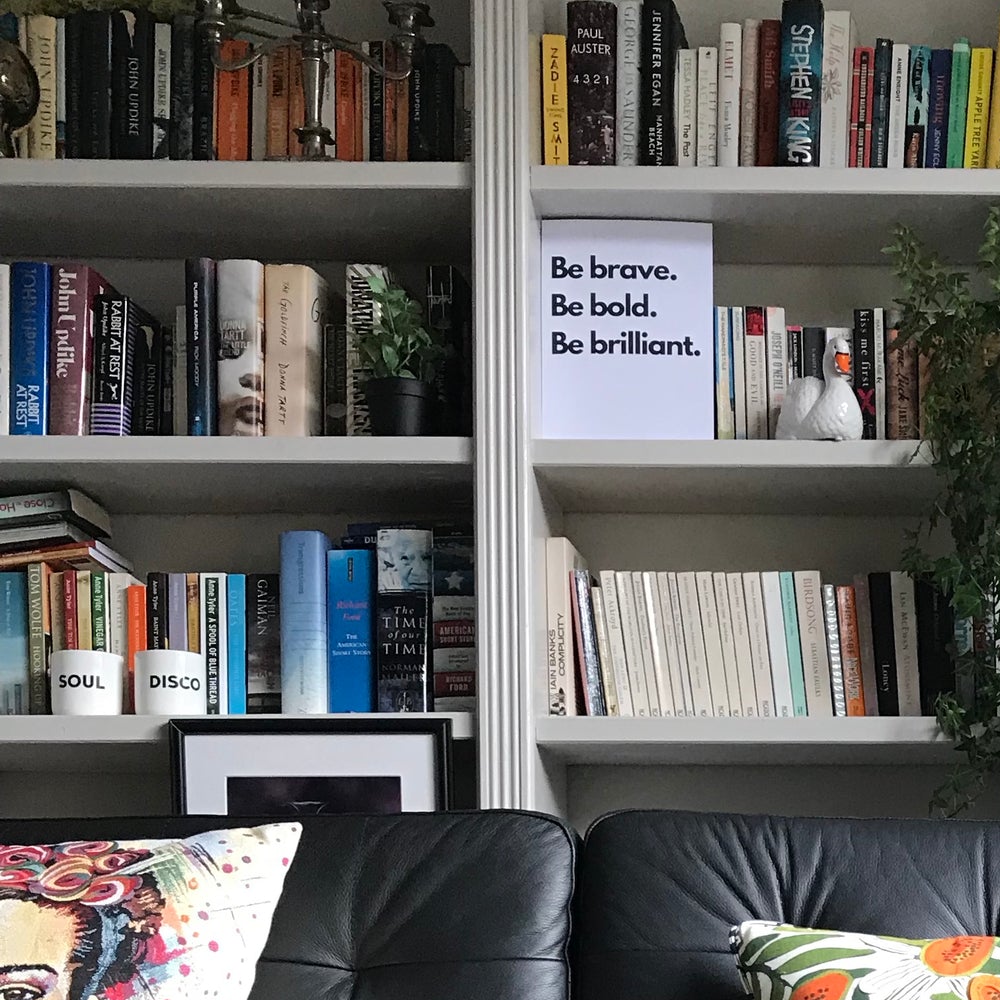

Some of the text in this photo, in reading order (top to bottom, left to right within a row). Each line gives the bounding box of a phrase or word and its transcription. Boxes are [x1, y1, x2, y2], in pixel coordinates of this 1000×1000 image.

[570, 43, 611, 56] AUSTER
[577, 27, 604, 39] PAUL
[624, 6, 637, 69] GEORGE
[651, 9, 662, 107] JENNIFER EGAN
[764, 48, 777, 89] Smith
[788, 23, 817, 101] STEPHEN
[549, 47, 560, 106] ZADIE
[40, 37, 52, 152] JOHN UPDIKE
[128, 57, 140, 137] JOHN UPDIKE
[682, 57, 692, 158] TESSA HADLEY The Past
[971, 96, 984, 148] APPLE TREE
[548, 121, 559, 165] SMIT
[648, 126, 656, 157] BEACH
[786, 116, 814, 164] KING
[551, 255, 678, 282] Be brave.
[57, 267, 79, 313] John
[192, 281, 200, 308] PURPLE
[551, 292, 657, 318] Be bold.
[108, 299, 123, 381] RABBIT AT REST
[192, 308, 200, 342] AMERICA
[54, 313, 79, 380] Updike
[551, 330, 702, 357] Be brilliant.
[749, 340, 759, 367] GOOD
[859, 310, 871, 388] kiss me first
[278, 362, 291, 392] DONNA
[771, 330, 784, 392] JOSEPH O'NEILL
[144, 362, 157, 432] JOHN UPDIKE
[750, 383, 759, 406] EVIL
[895, 368, 910, 402] Luck
[15, 383, 28, 428] AT REST
[27, 383, 40, 426] RABBIT
[29, 566, 40, 598] TOM
[207, 579, 217, 597] Anne
[31, 598, 42, 639] WOLFE
[64, 595, 73, 610] Tyler
[93, 576, 105, 647] Anne Tyler VINEGAR
[151, 595, 160, 611] Tyler
[206, 597, 217, 615] Tyler
[256, 579, 269, 636] GAIMAN
[267, 595, 277, 620] NEIL
[394, 604, 415, 616] The
[605, 576, 619, 630] Peter Ackroyd
[802, 576, 818, 635] BIRDSONG
[208, 623, 217, 646] SPOOL
[382, 617, 426, 629] TIME
[387, 630, 421, 642] of our
[209, 647, 217, 658] OF
[382, 643, 426, 656] TIME
[549, 628, 557, 691] IAIN BANKS
[556, 612, 566, 677] COMPLICITY
[31, 645, 41, 690] HOOKING
[59, 674, 106, 690] SOUL
[149, 674, 201, 691] DISCO
[208, 658, 218, 676] BLUE
[381, 662, 426, 673] NORMAN
[881, 663, 892, 693] Loney
[209, 677, 218, 705] THREAD
